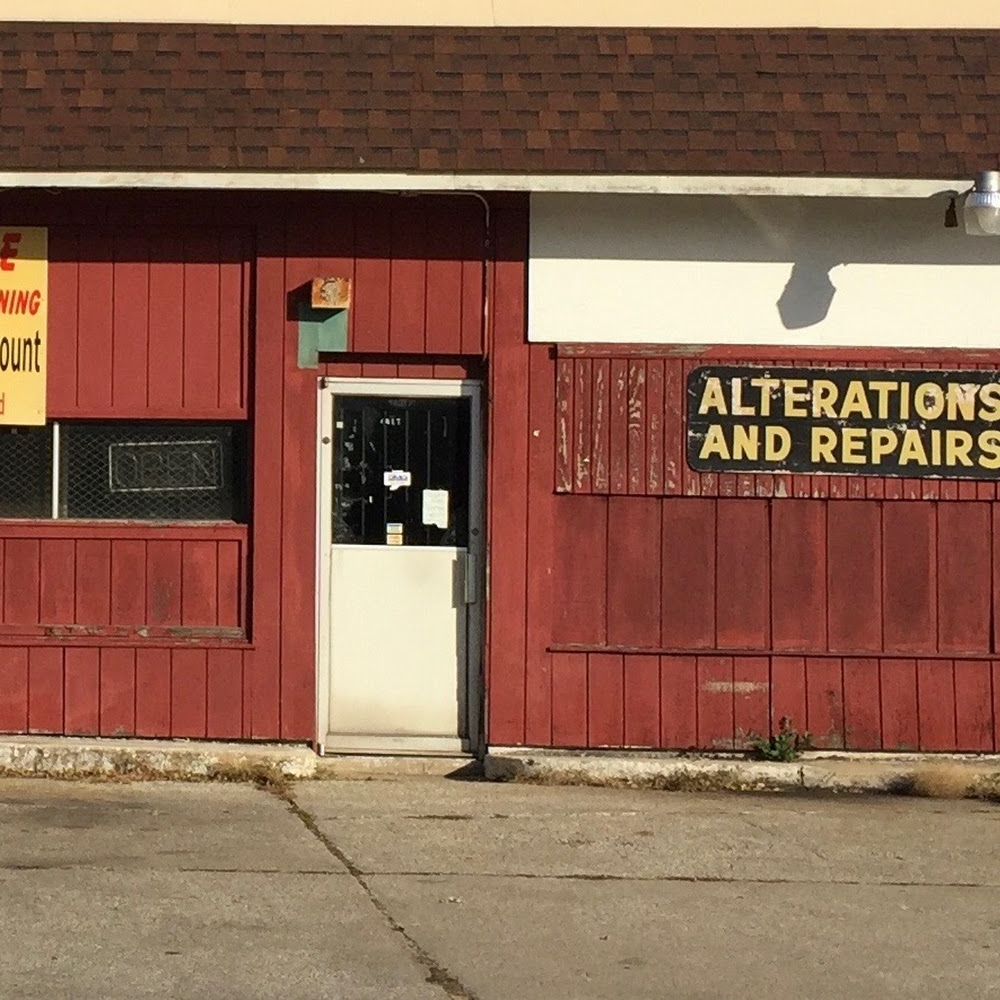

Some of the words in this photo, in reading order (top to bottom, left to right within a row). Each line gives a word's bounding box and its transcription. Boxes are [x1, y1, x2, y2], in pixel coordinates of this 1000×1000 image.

[699, 377, 1000, 422] ALTERATIONS
[699, 425, 792, 461] AND
[811, 427, 1000, 469] REPAIRS
